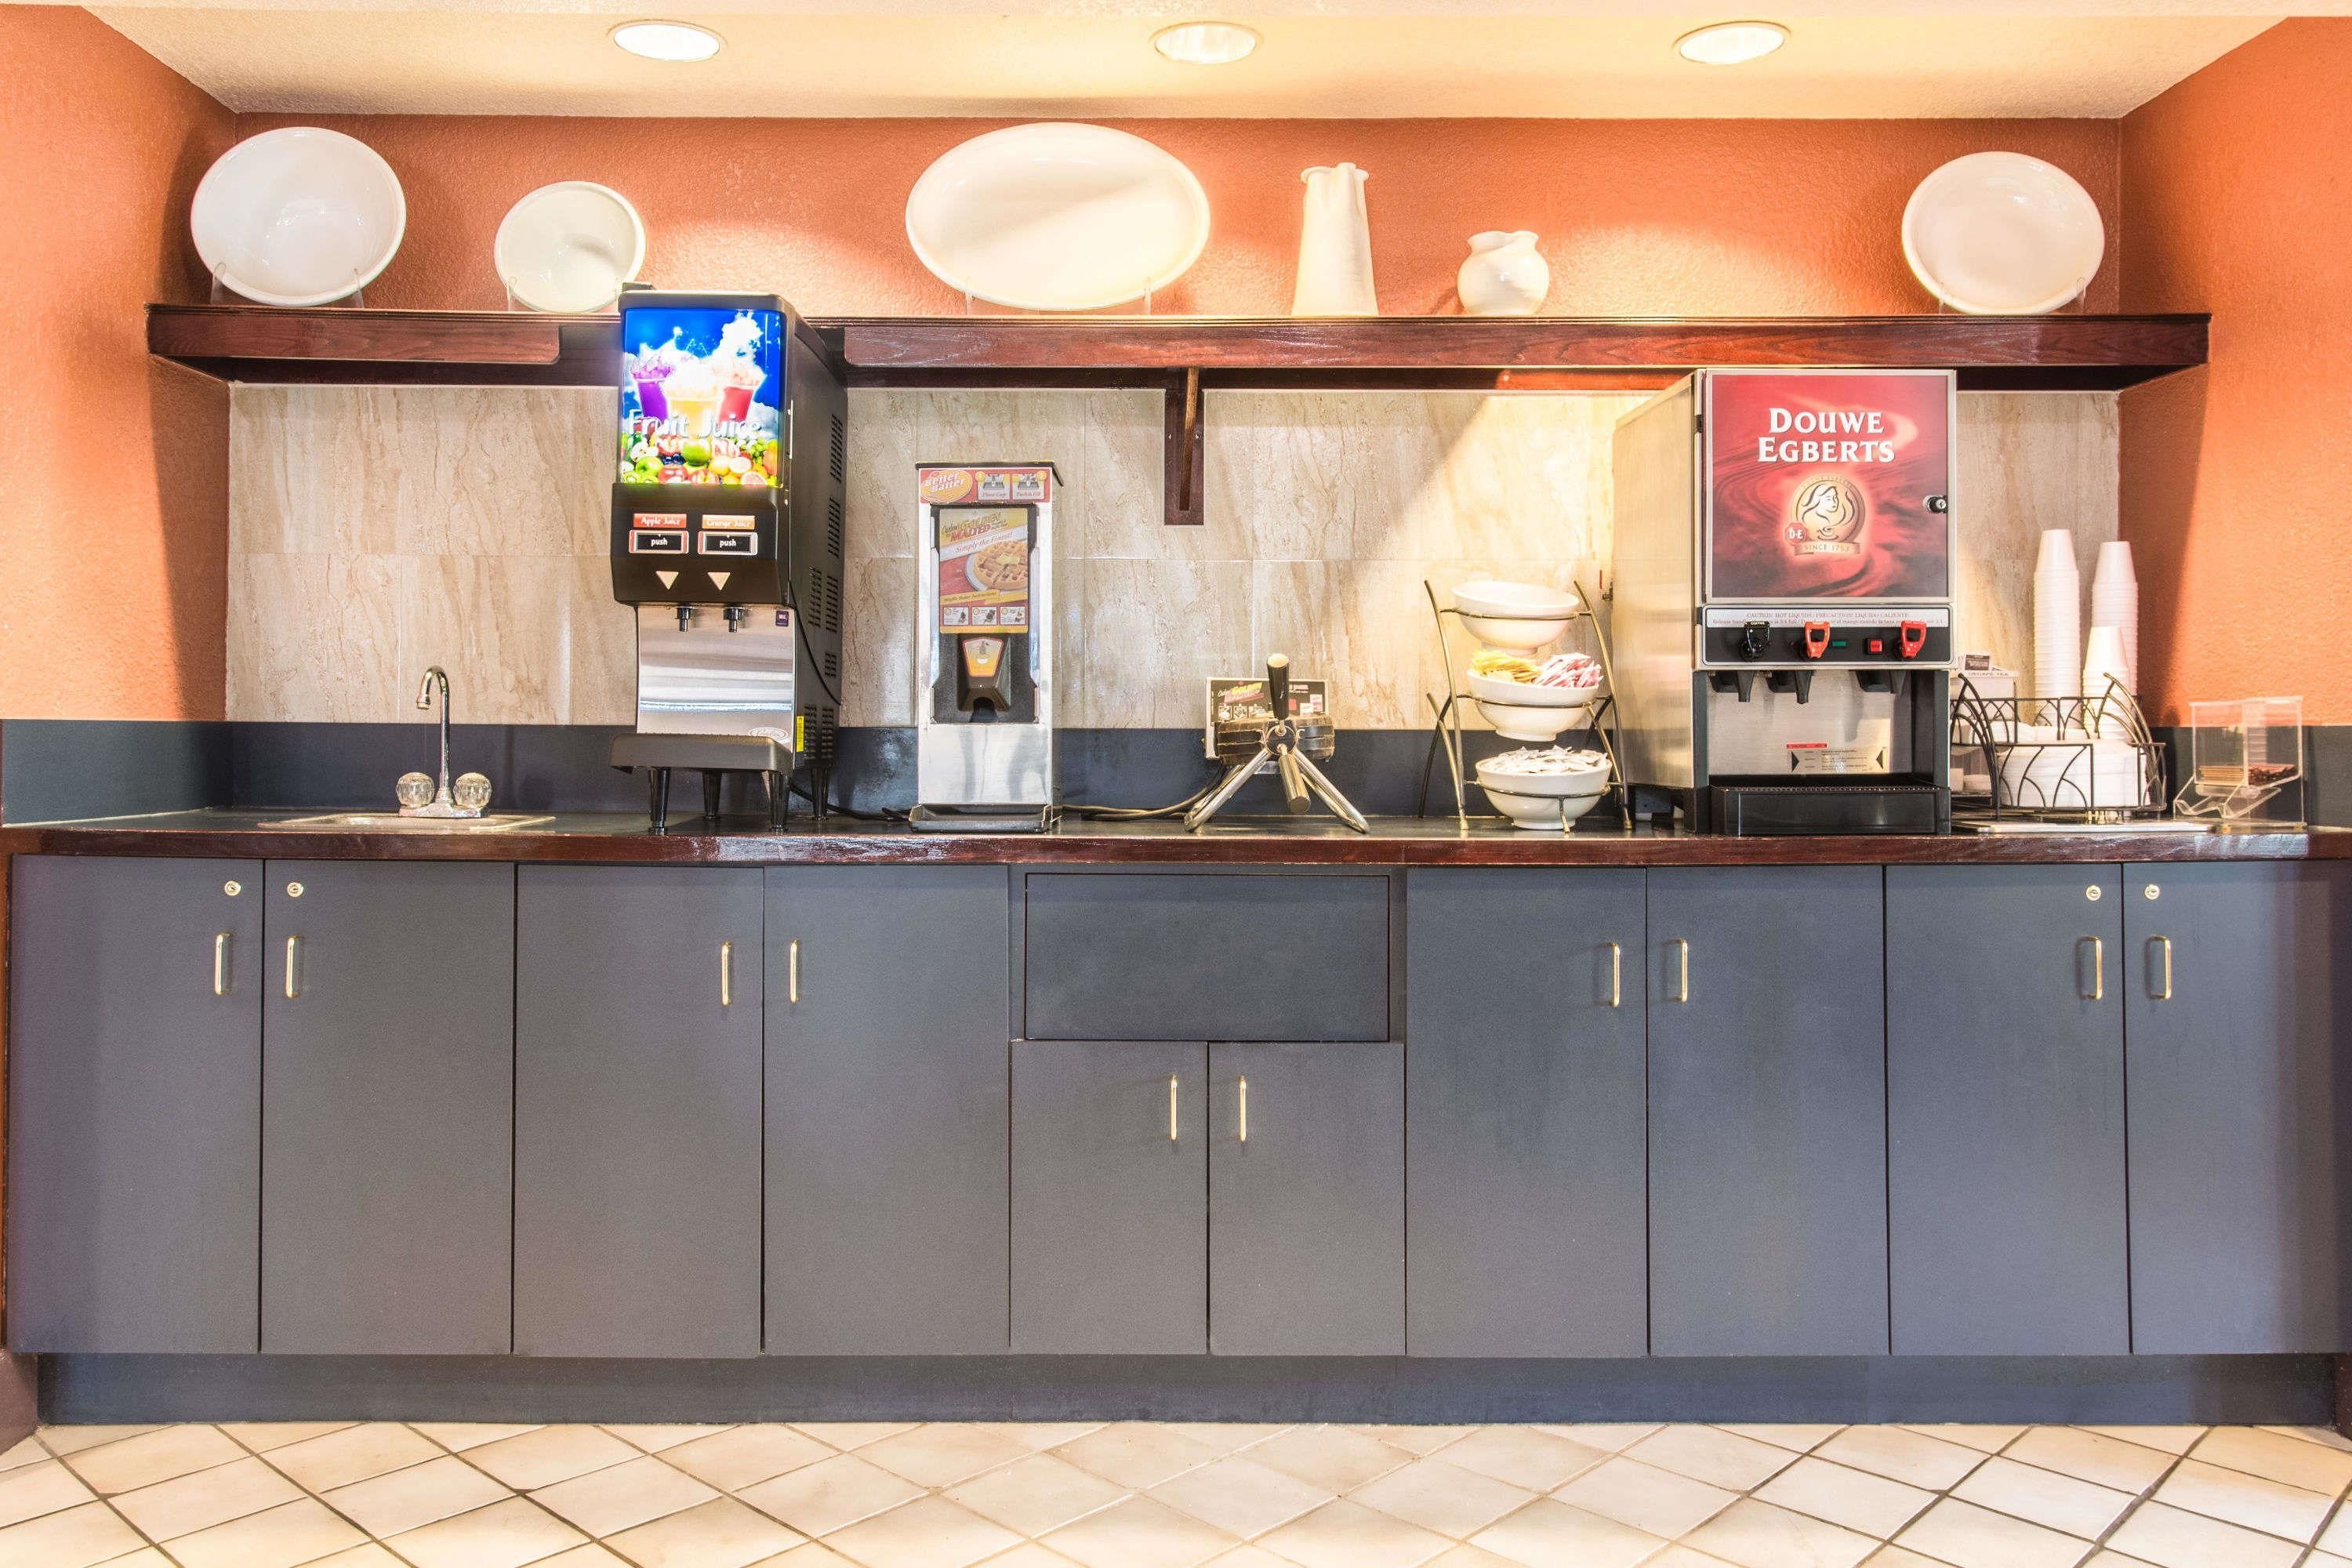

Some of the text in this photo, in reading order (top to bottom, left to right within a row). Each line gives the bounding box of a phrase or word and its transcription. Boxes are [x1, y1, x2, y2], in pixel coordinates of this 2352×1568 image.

[628, 408, 762, 439] Fruit Juice
[1768, 407, 1885, 434] DOUWE
[1757, 436, 1896, 463] EGBERTS
[641, 516, 681, 527] Apple Juice
[706, 520, 732, 528] Orange
[651, 538, 668, 547] push
[720, 539, 737, 548] push
